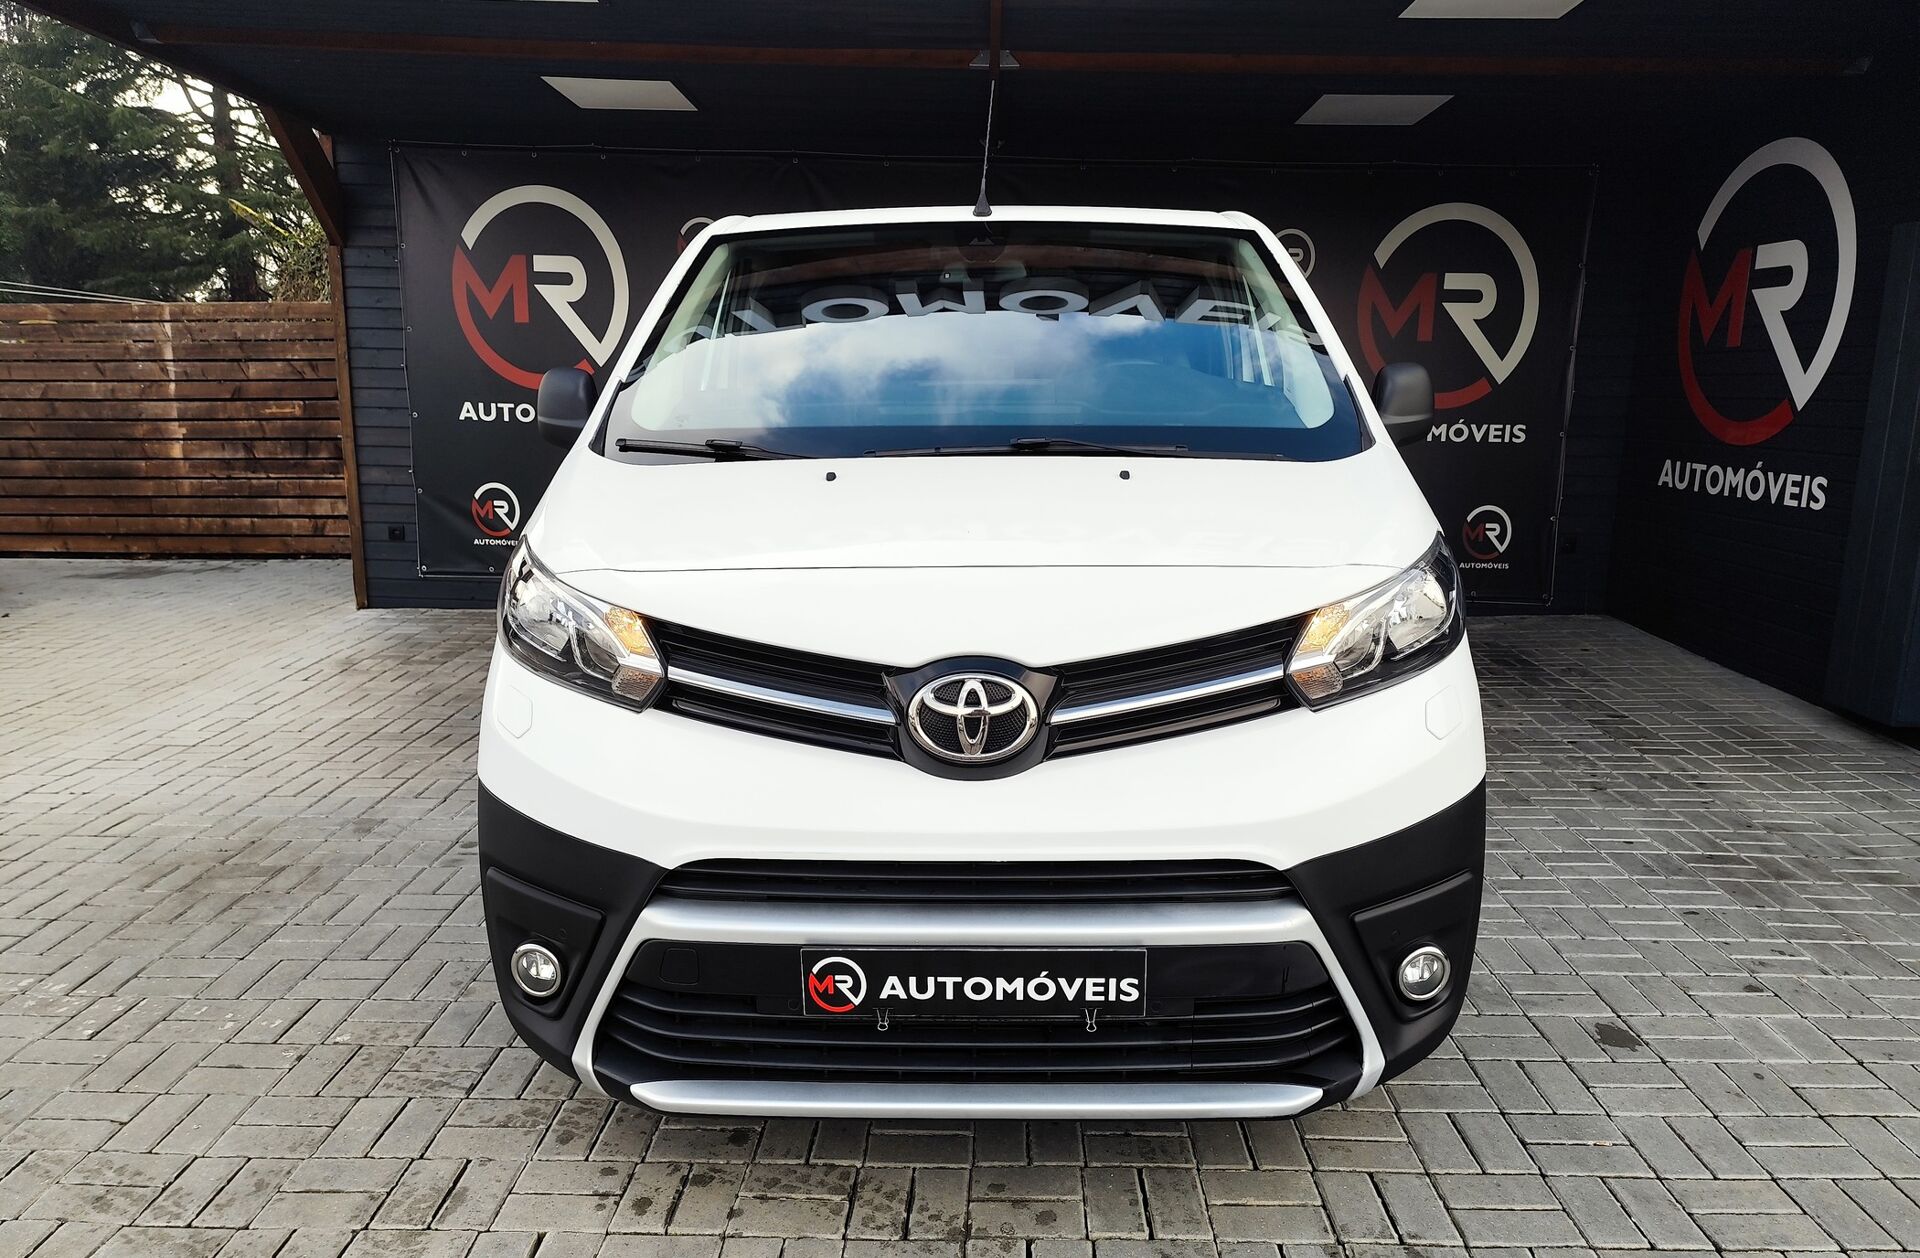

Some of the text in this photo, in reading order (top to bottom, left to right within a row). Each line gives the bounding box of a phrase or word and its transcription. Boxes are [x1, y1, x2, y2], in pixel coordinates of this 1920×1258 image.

[459, 401, 536, 423] AUTO
[1426, 418, 1527, 444] MÓVEIS
[1657, 459, 1829, 511] AUTOMÓVEIS
[473, 538, 519, 547] AUTOMÓVEI
[1459, 562, 1510, 570] AUTOMÓVEIS
[879, 970, 1140, 1002] AUTOMÓVEIS
